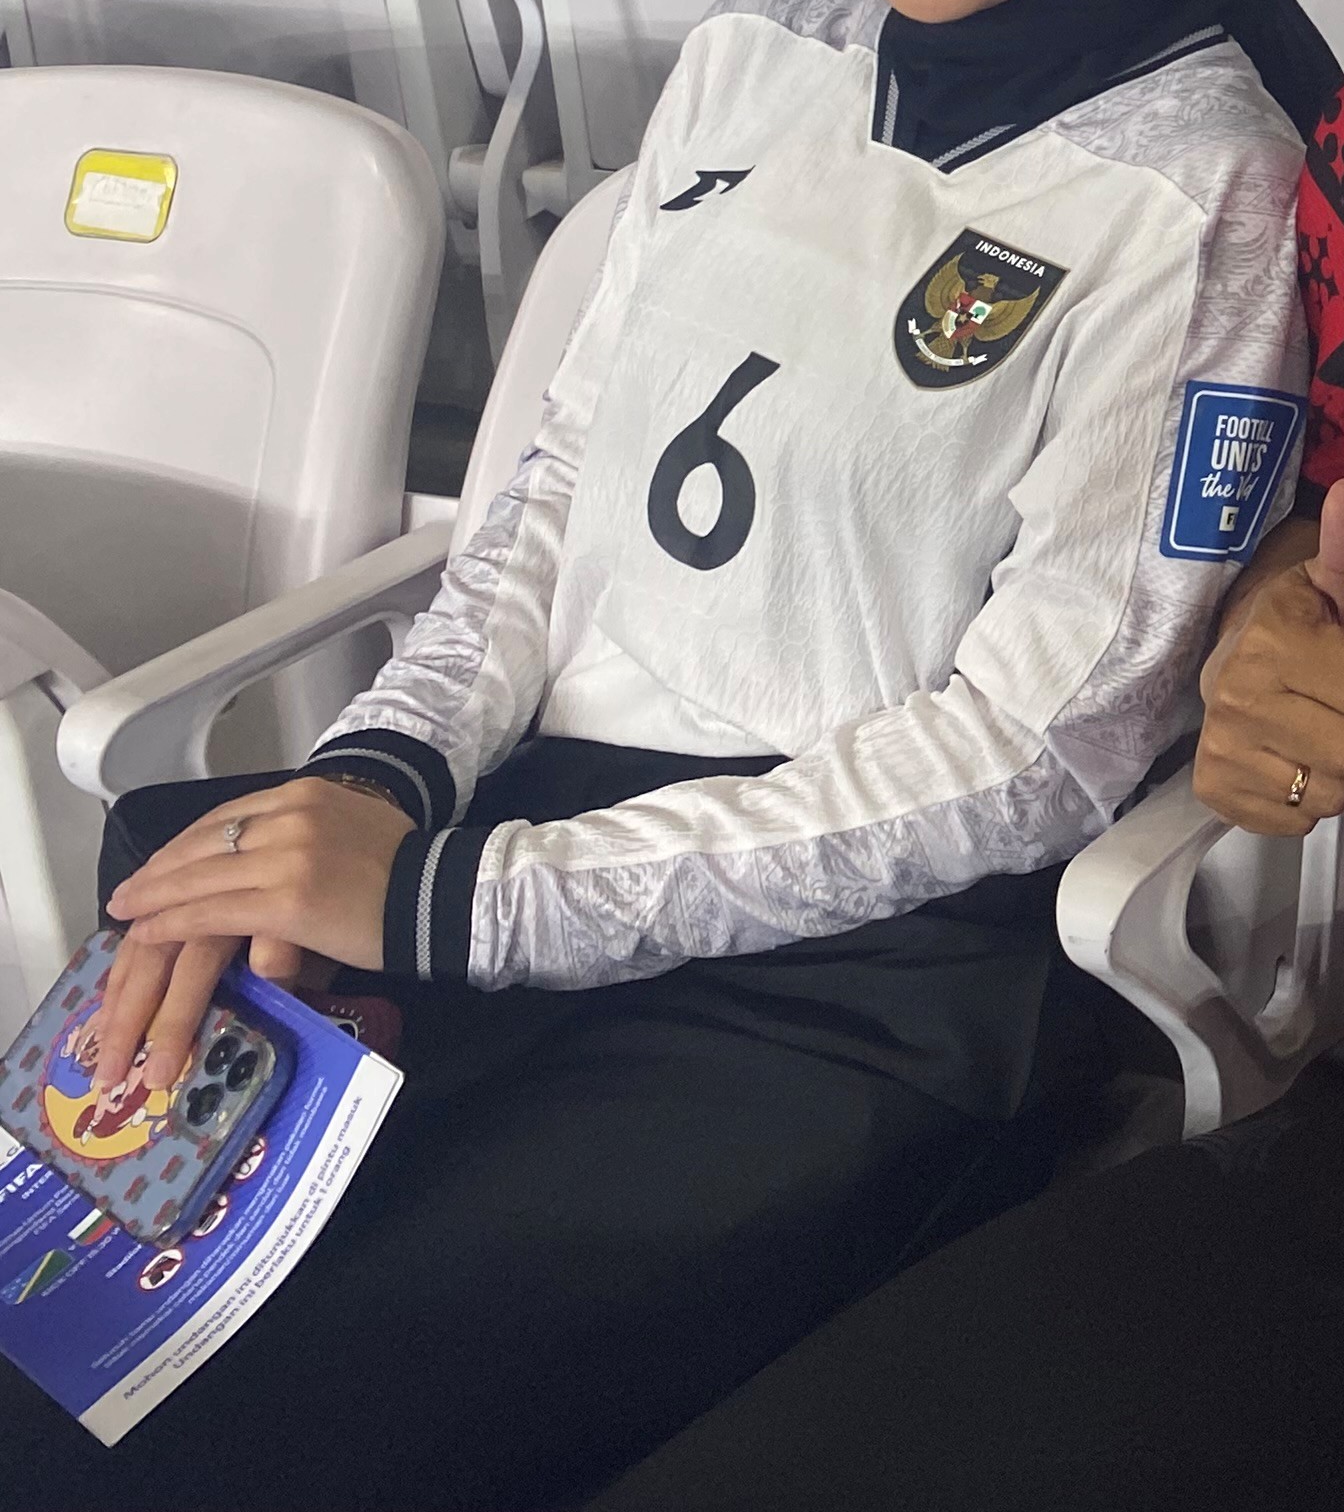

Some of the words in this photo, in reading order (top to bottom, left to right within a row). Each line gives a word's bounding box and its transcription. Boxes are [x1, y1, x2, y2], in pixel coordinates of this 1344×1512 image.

[975, 240, 1046, 278] INDONESIA
[647, 350, 781, 572] 6
[1200, 472, 1235, 498] the
[122, 1354, 171, 1401] Mohon
[171, 1294, 236, 1358] undangan
[234, 1275, 252, 1295] ini
[250, 1196, 310, 1278] ditunjukkan
[306, 1181, 319, 1196] di
[315, 1142, 340, 1181] pintu
[334, 1095, 363, 1142] masuk
[172, 1305, 240, 1371] Undangan
[238, 1288, 256, 1306] ini
[254, 1237, 297, 1289] berlaku
[292, 1195, 323, 1237] untuk
[324, 1144, 352, 1187] orang
